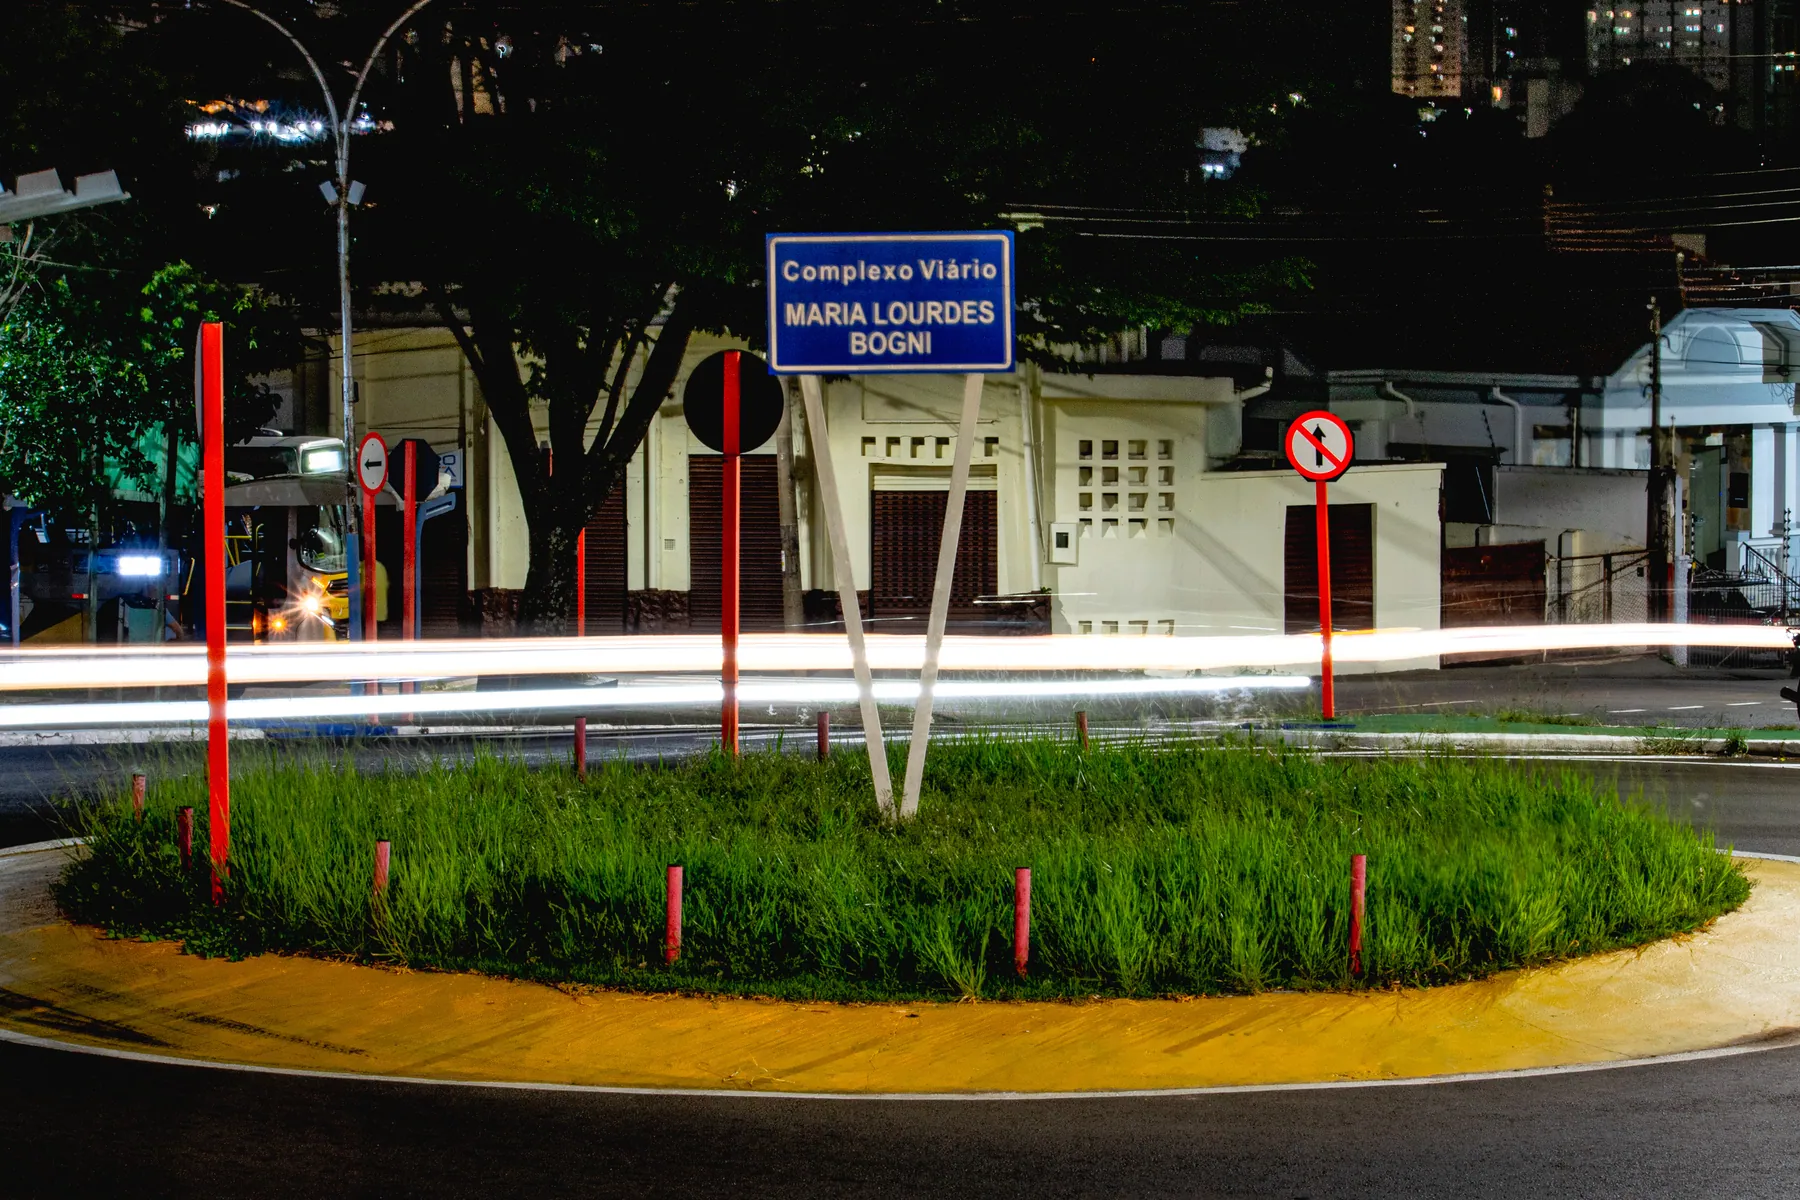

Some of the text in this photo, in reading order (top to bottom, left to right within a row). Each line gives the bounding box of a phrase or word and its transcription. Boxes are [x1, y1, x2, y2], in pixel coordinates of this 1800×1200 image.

[783, 258, 998, 285] Complexo Viário
[785, 301, 995, 326] MARIA LOURDES
[850, 331, 932, 355] BOGNI
